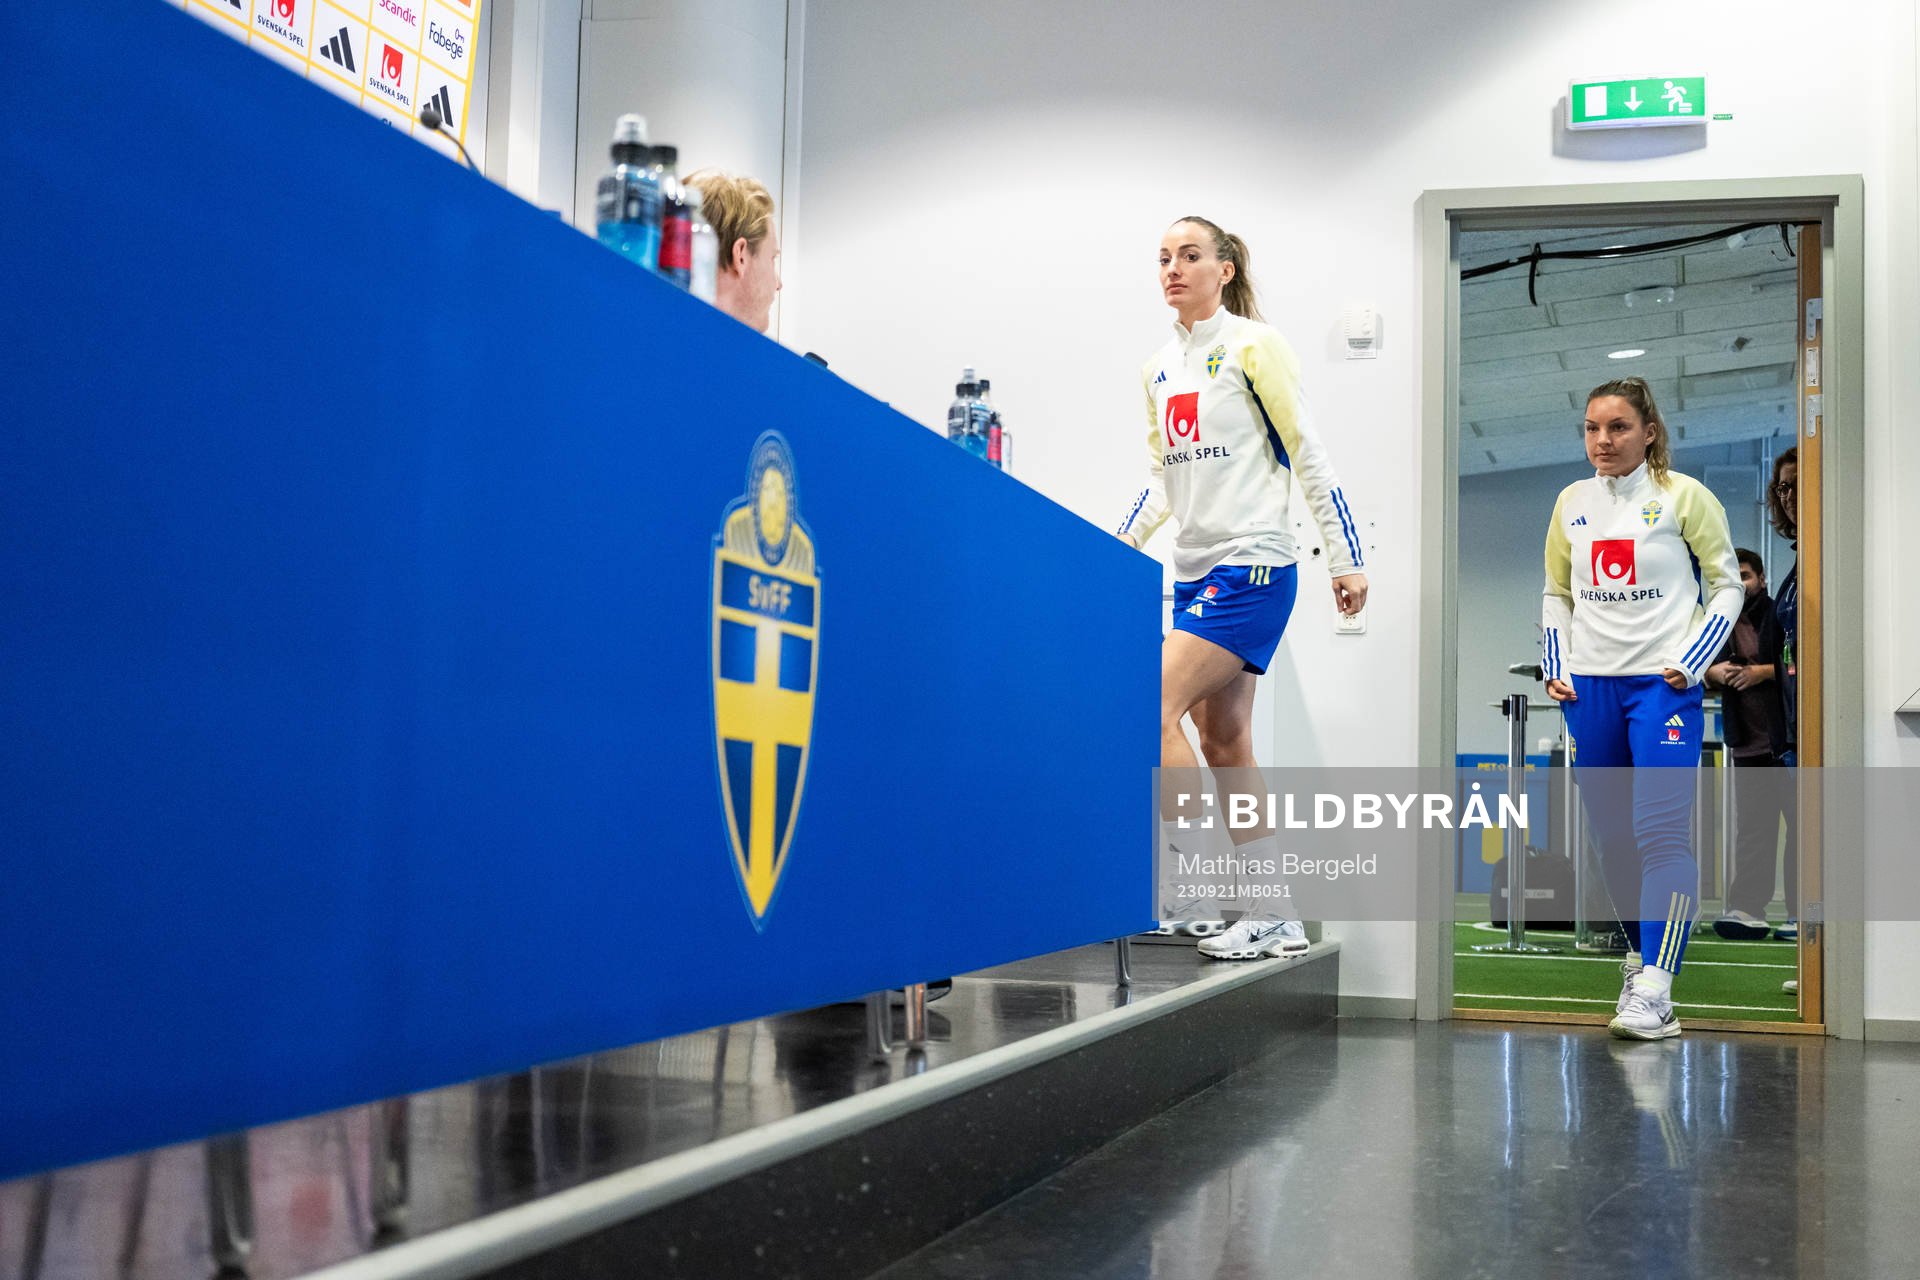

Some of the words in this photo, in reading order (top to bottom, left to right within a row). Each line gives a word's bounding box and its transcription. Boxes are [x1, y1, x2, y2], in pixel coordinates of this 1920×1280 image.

[378, 0, 416, 27] Scandic
[257, 14, 288, 38] SVENSKA
[289, 32, 304, 48] SPEL
[429, 21, 464, 60] Fabege
[369, 77, 396, 98] SVENSKA
[396, 92, 410, 106] SPEL
[1195, 446, 1231, 460] SPEL
[1580, 589, 1627, 602] SVENSKA
[1631, 588, 1663, 601] SPEL
